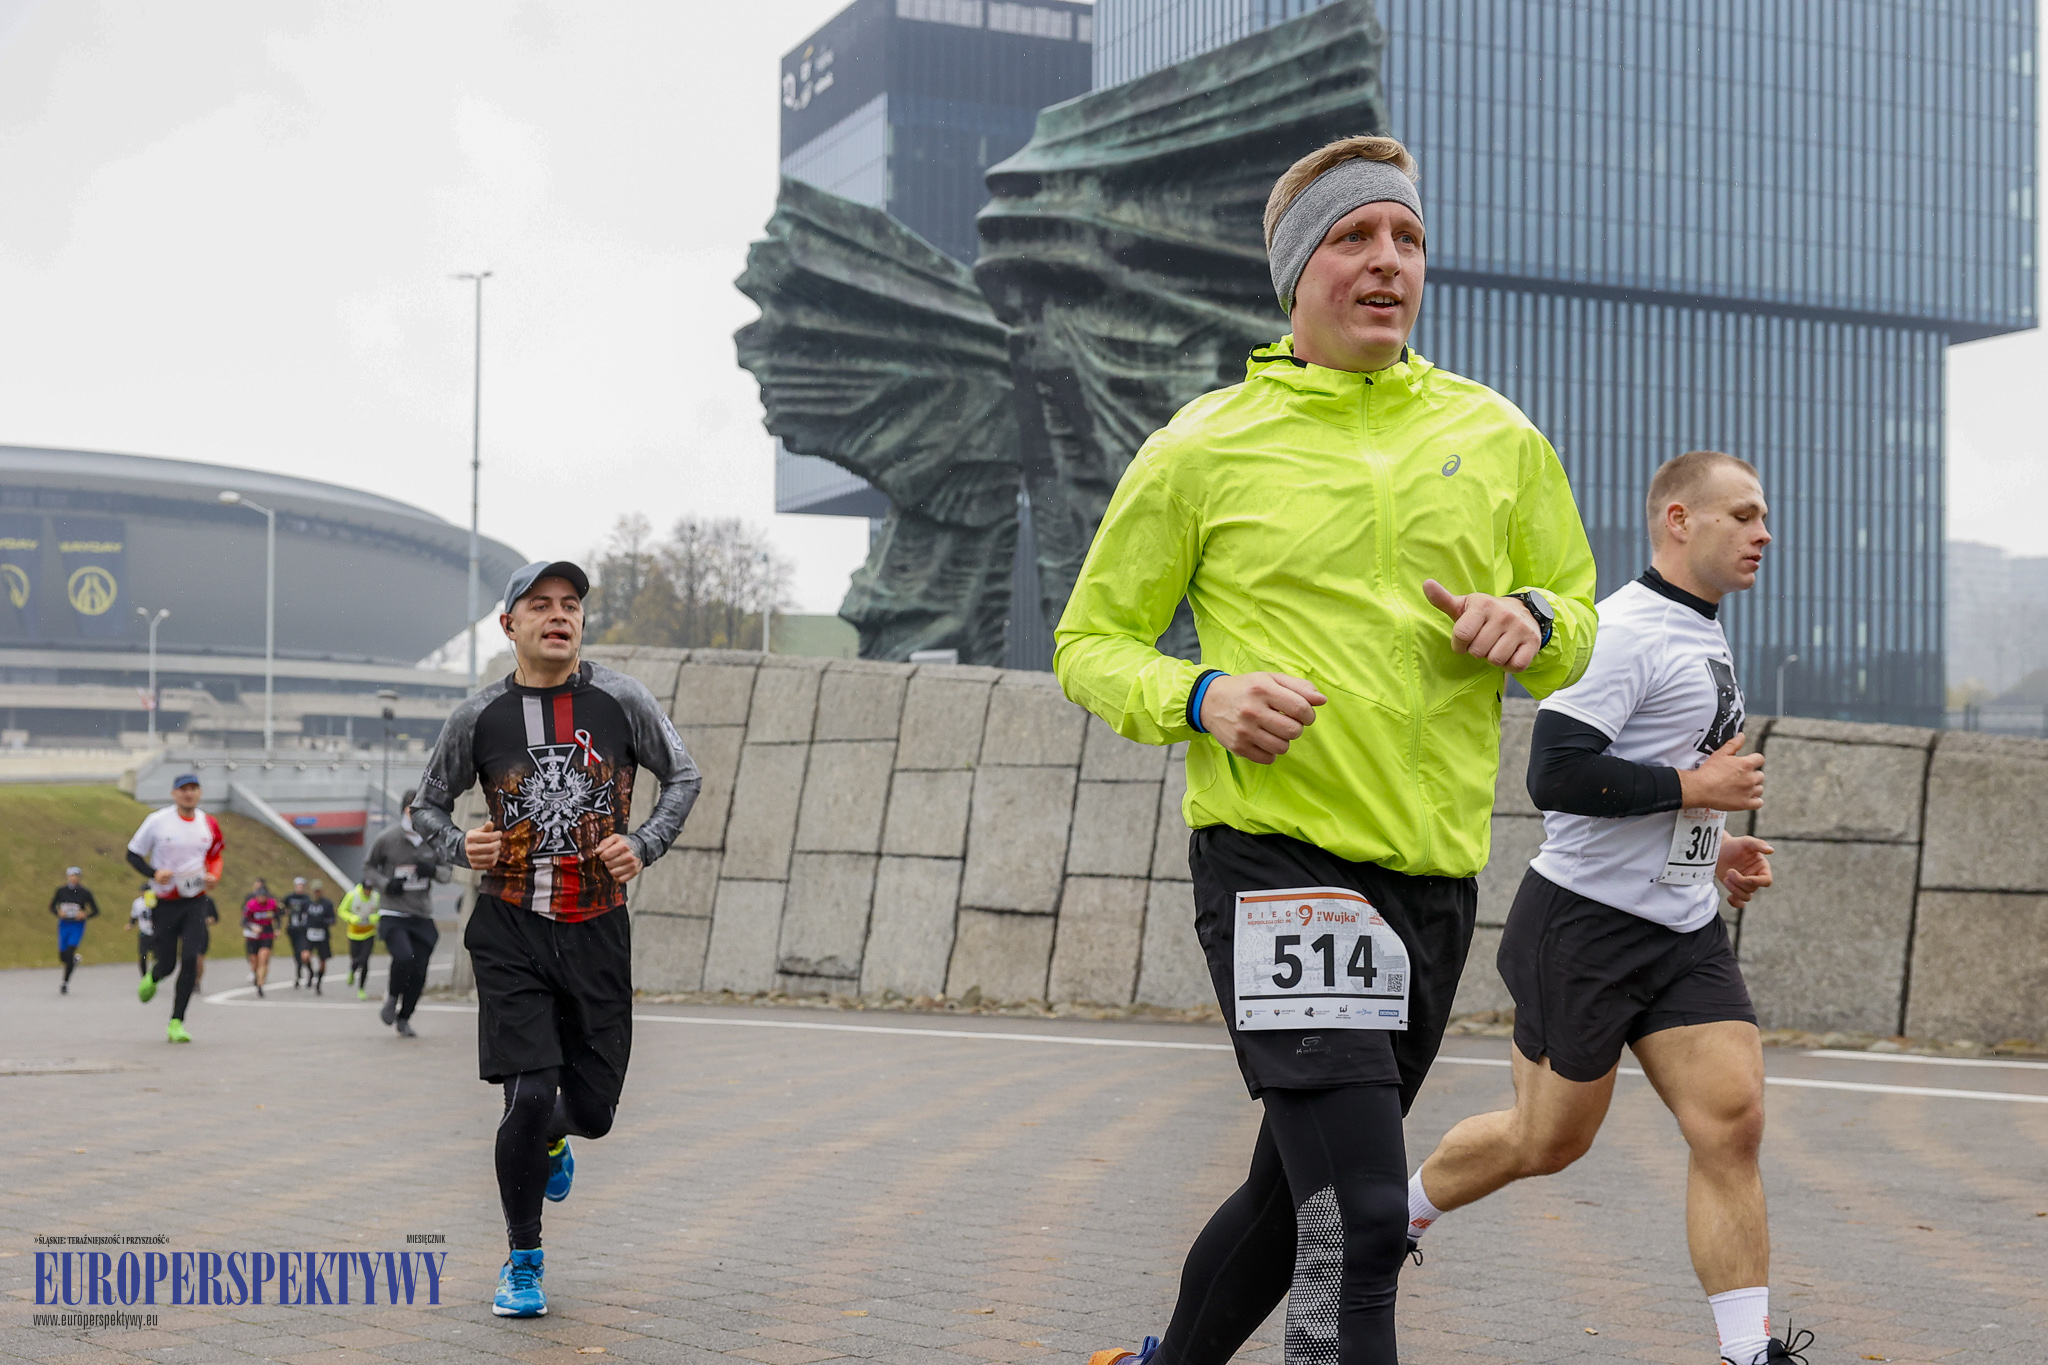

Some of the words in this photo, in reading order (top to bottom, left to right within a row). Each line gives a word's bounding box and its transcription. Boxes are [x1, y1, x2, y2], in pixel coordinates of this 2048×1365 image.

[506, 801, 519, 817] N
[594, 790, 607, 808] Z
[1686, 826, 1719, 861] 301
[1298, 904, 1313, 926] 9
[1317, 911, 1360, 924] "Wujka"
[1271, 933, 1378, 989] 514
